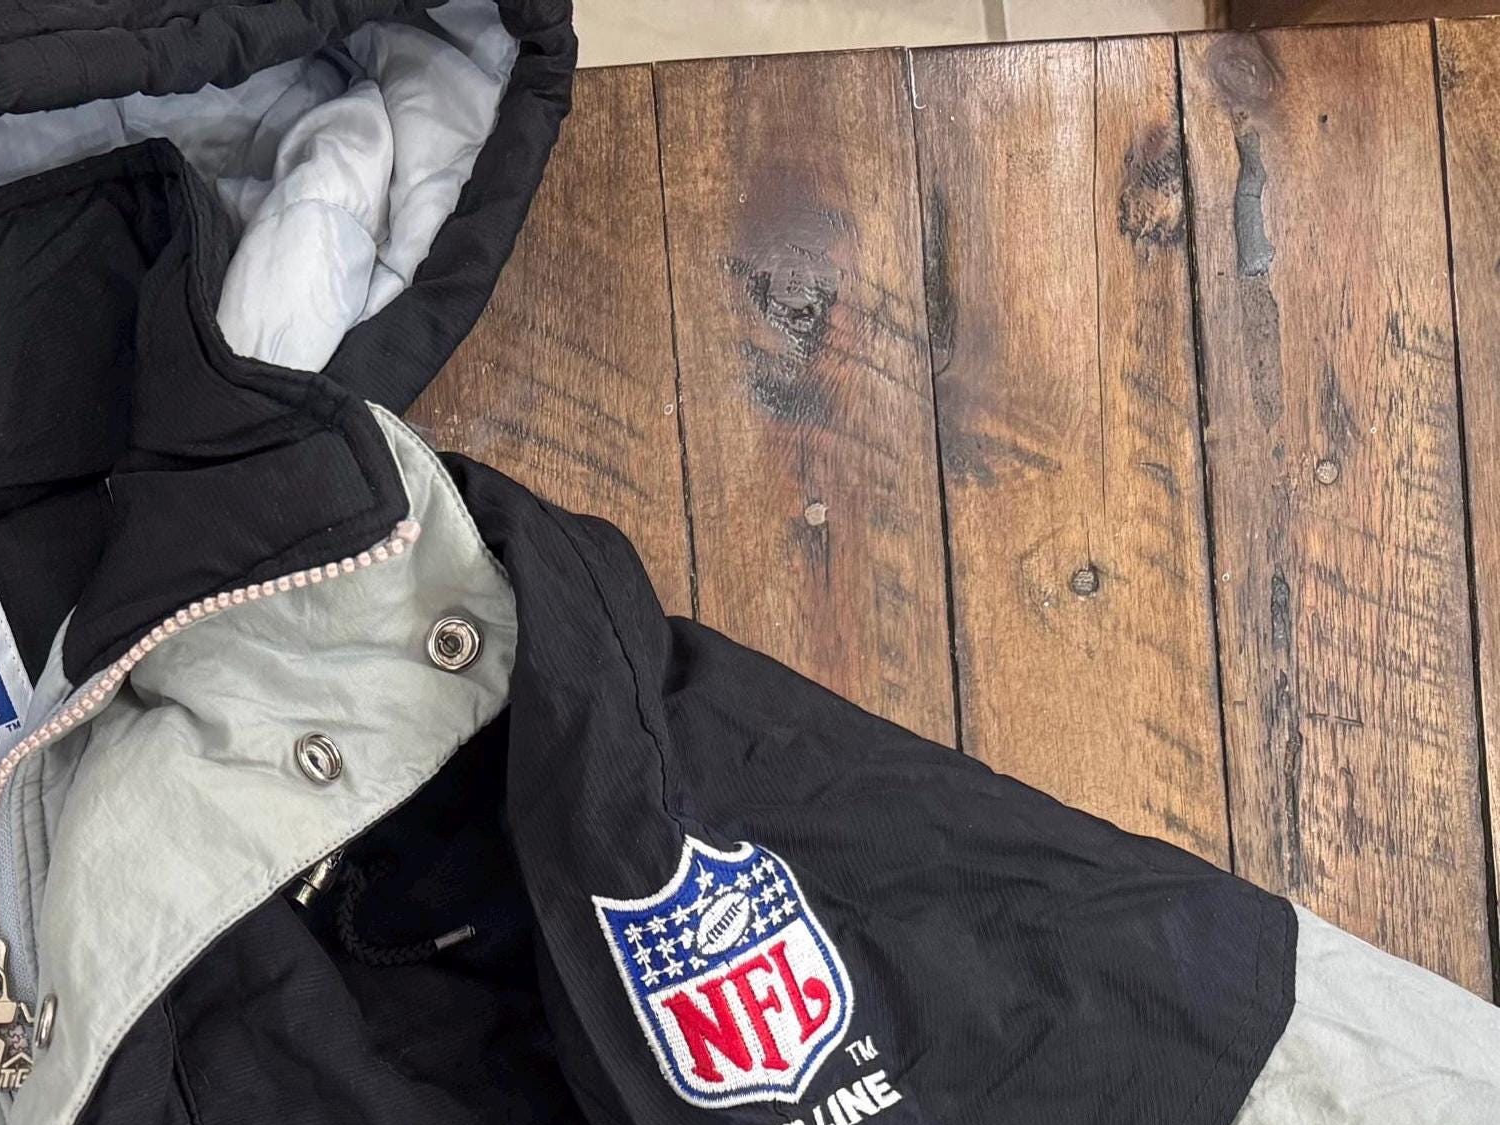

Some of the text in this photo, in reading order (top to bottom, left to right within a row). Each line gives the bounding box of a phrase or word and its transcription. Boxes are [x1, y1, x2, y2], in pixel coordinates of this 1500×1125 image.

[5, 720, 23, 733] TM
[660, 939, 832, 1083] NFL
[844, 1034, 879, 1067] TM
